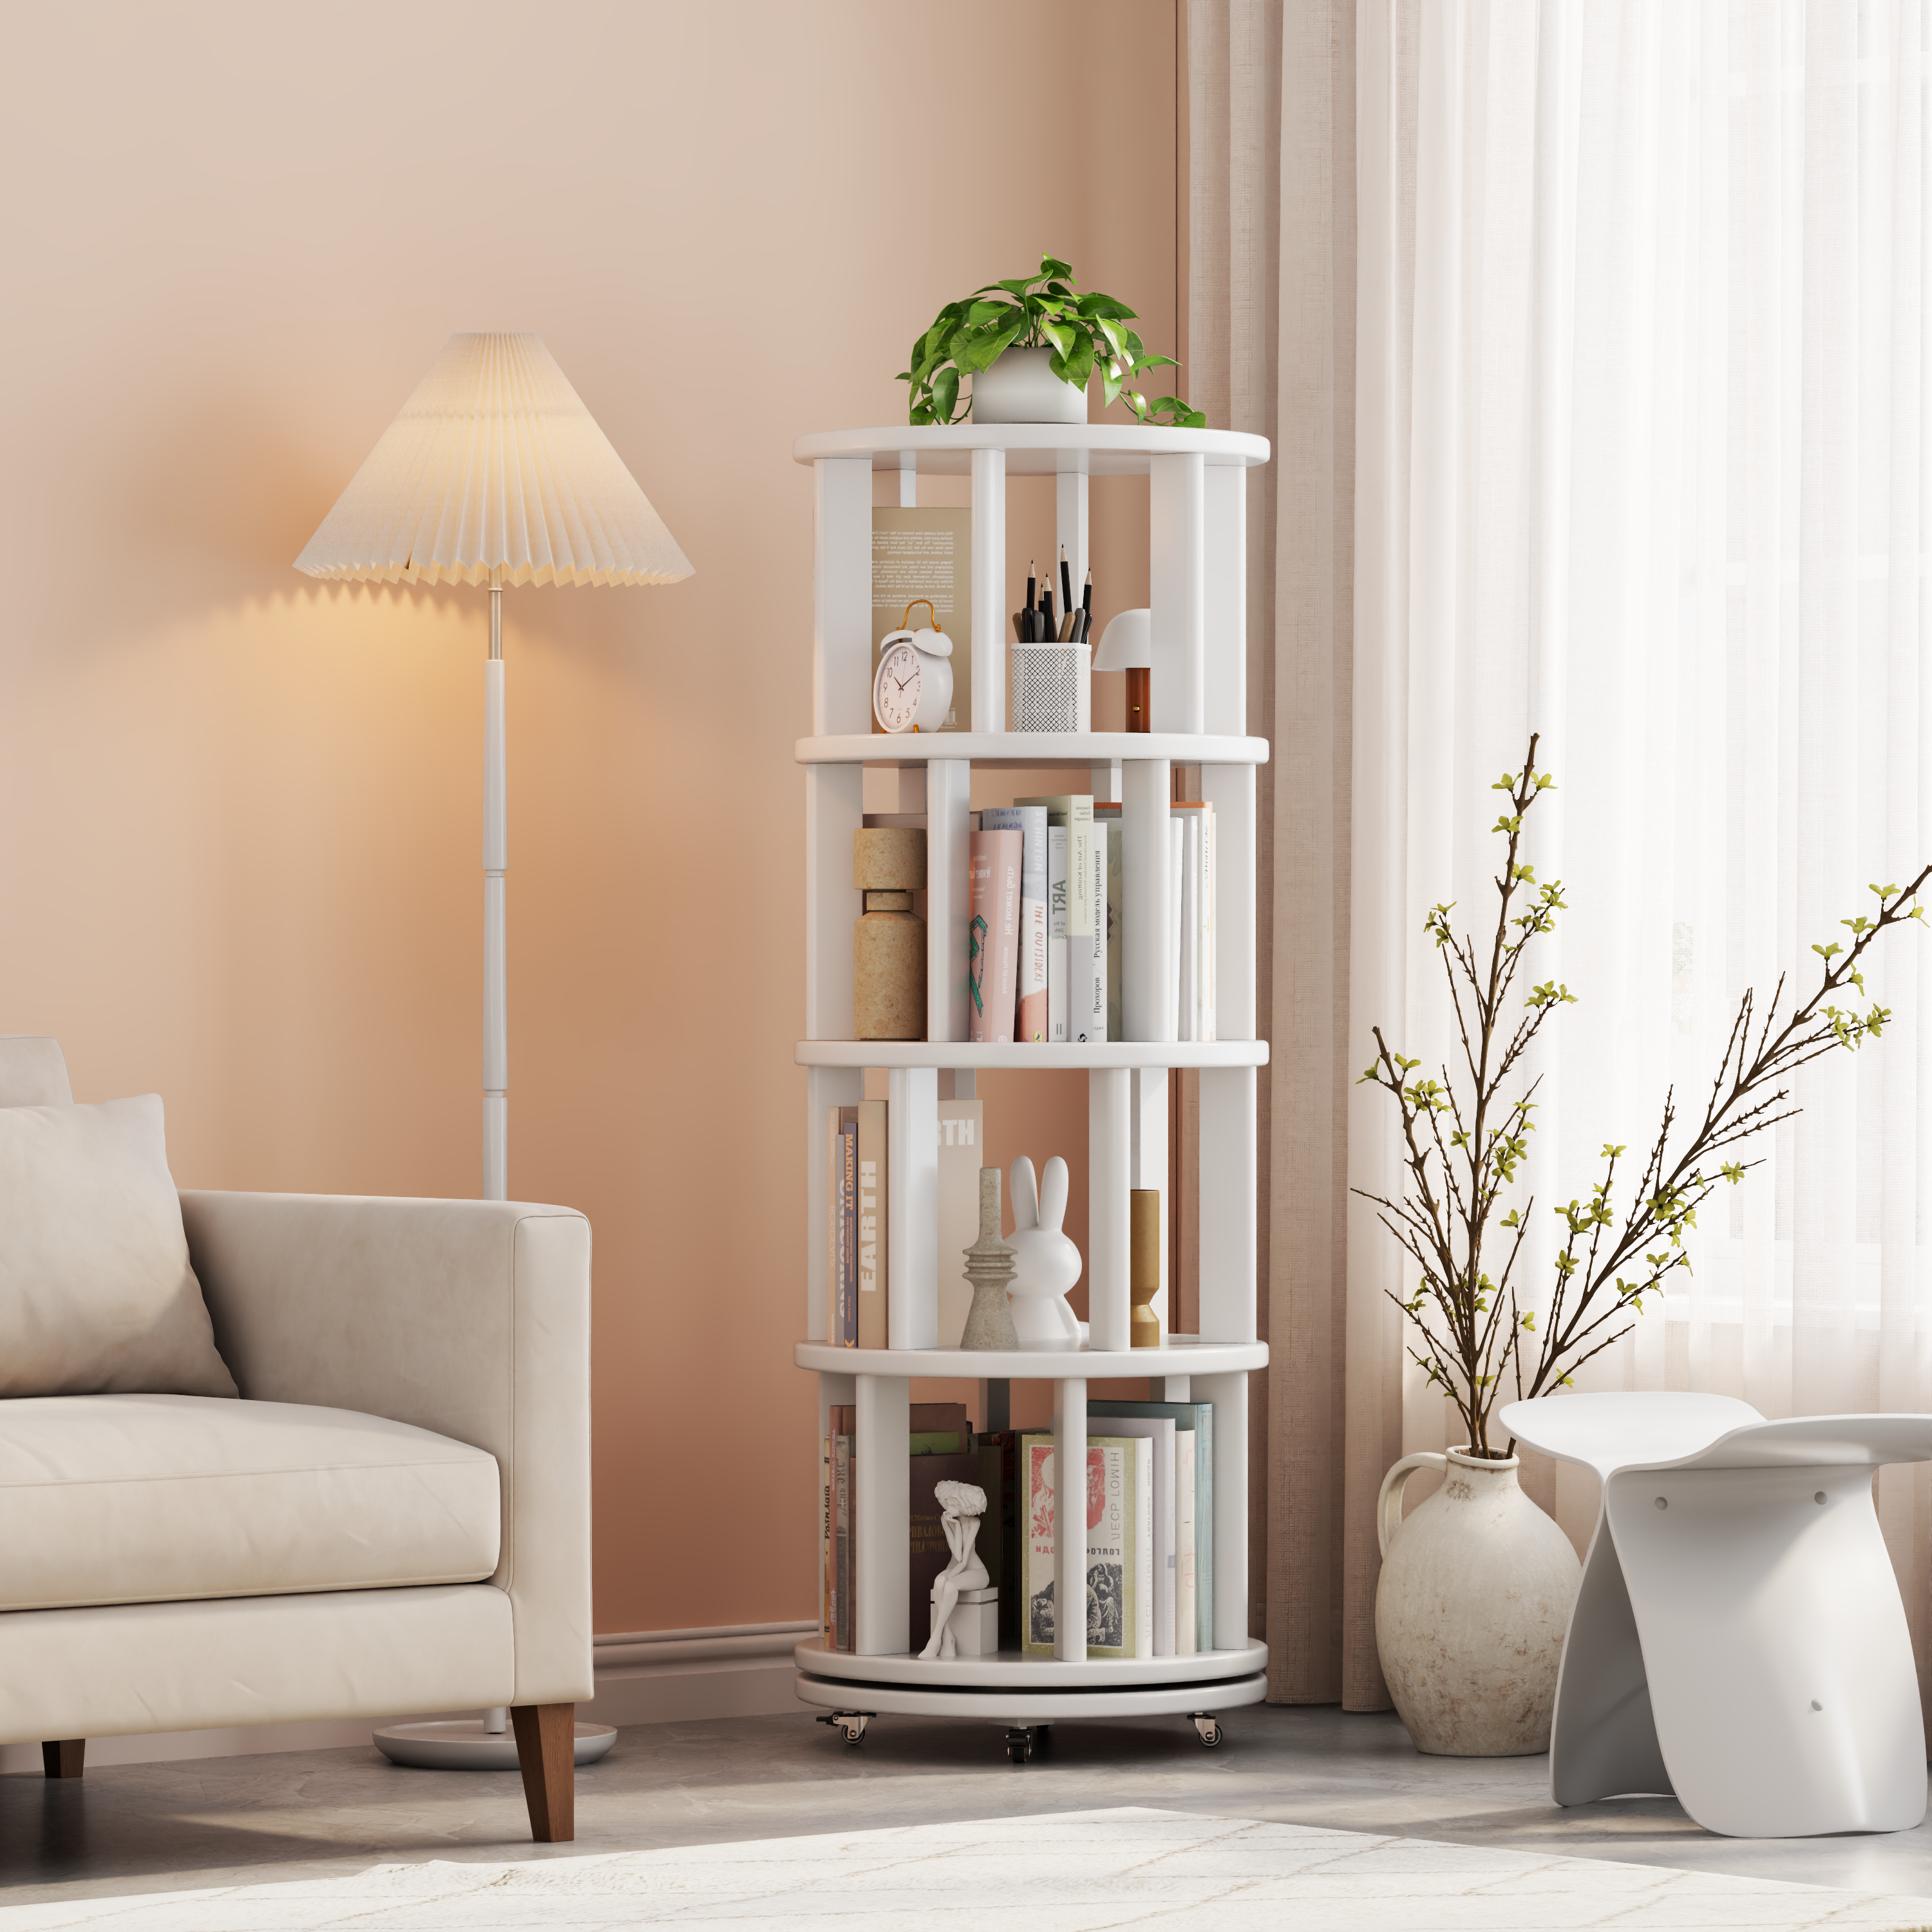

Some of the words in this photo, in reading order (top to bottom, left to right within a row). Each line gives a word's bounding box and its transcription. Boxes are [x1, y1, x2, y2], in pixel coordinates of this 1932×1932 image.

[894, 657, 898, 666] 11
[902, 652, 907, 661] 12
[912, 656, 913, 665] 1
[887, 668, 892, 677] 10
[916, 666, 920, 675] 2
[884, 683, 887, 692] 9
[917, 681, 920, 692] 3
[884, 698, 888, 708] 8
[913, 698, 917, 707] 4
[890, 709, 894, 718] 7
[897, 713, 901, 723] 6
[906, 708, 910, 718] 5
[1034, 827, 1043, 871] HINTON
[1035, 906, 1043, 925] THE
[1094, 928, 1102, 958] Русская
[1034, 932, 1044, 983] OUTSIDERS
[1094, 977, 1102, 1013] Прохоров
[846, 1195, 853, 1210] IT
[861, 1161, 876, 1291] EARTH
